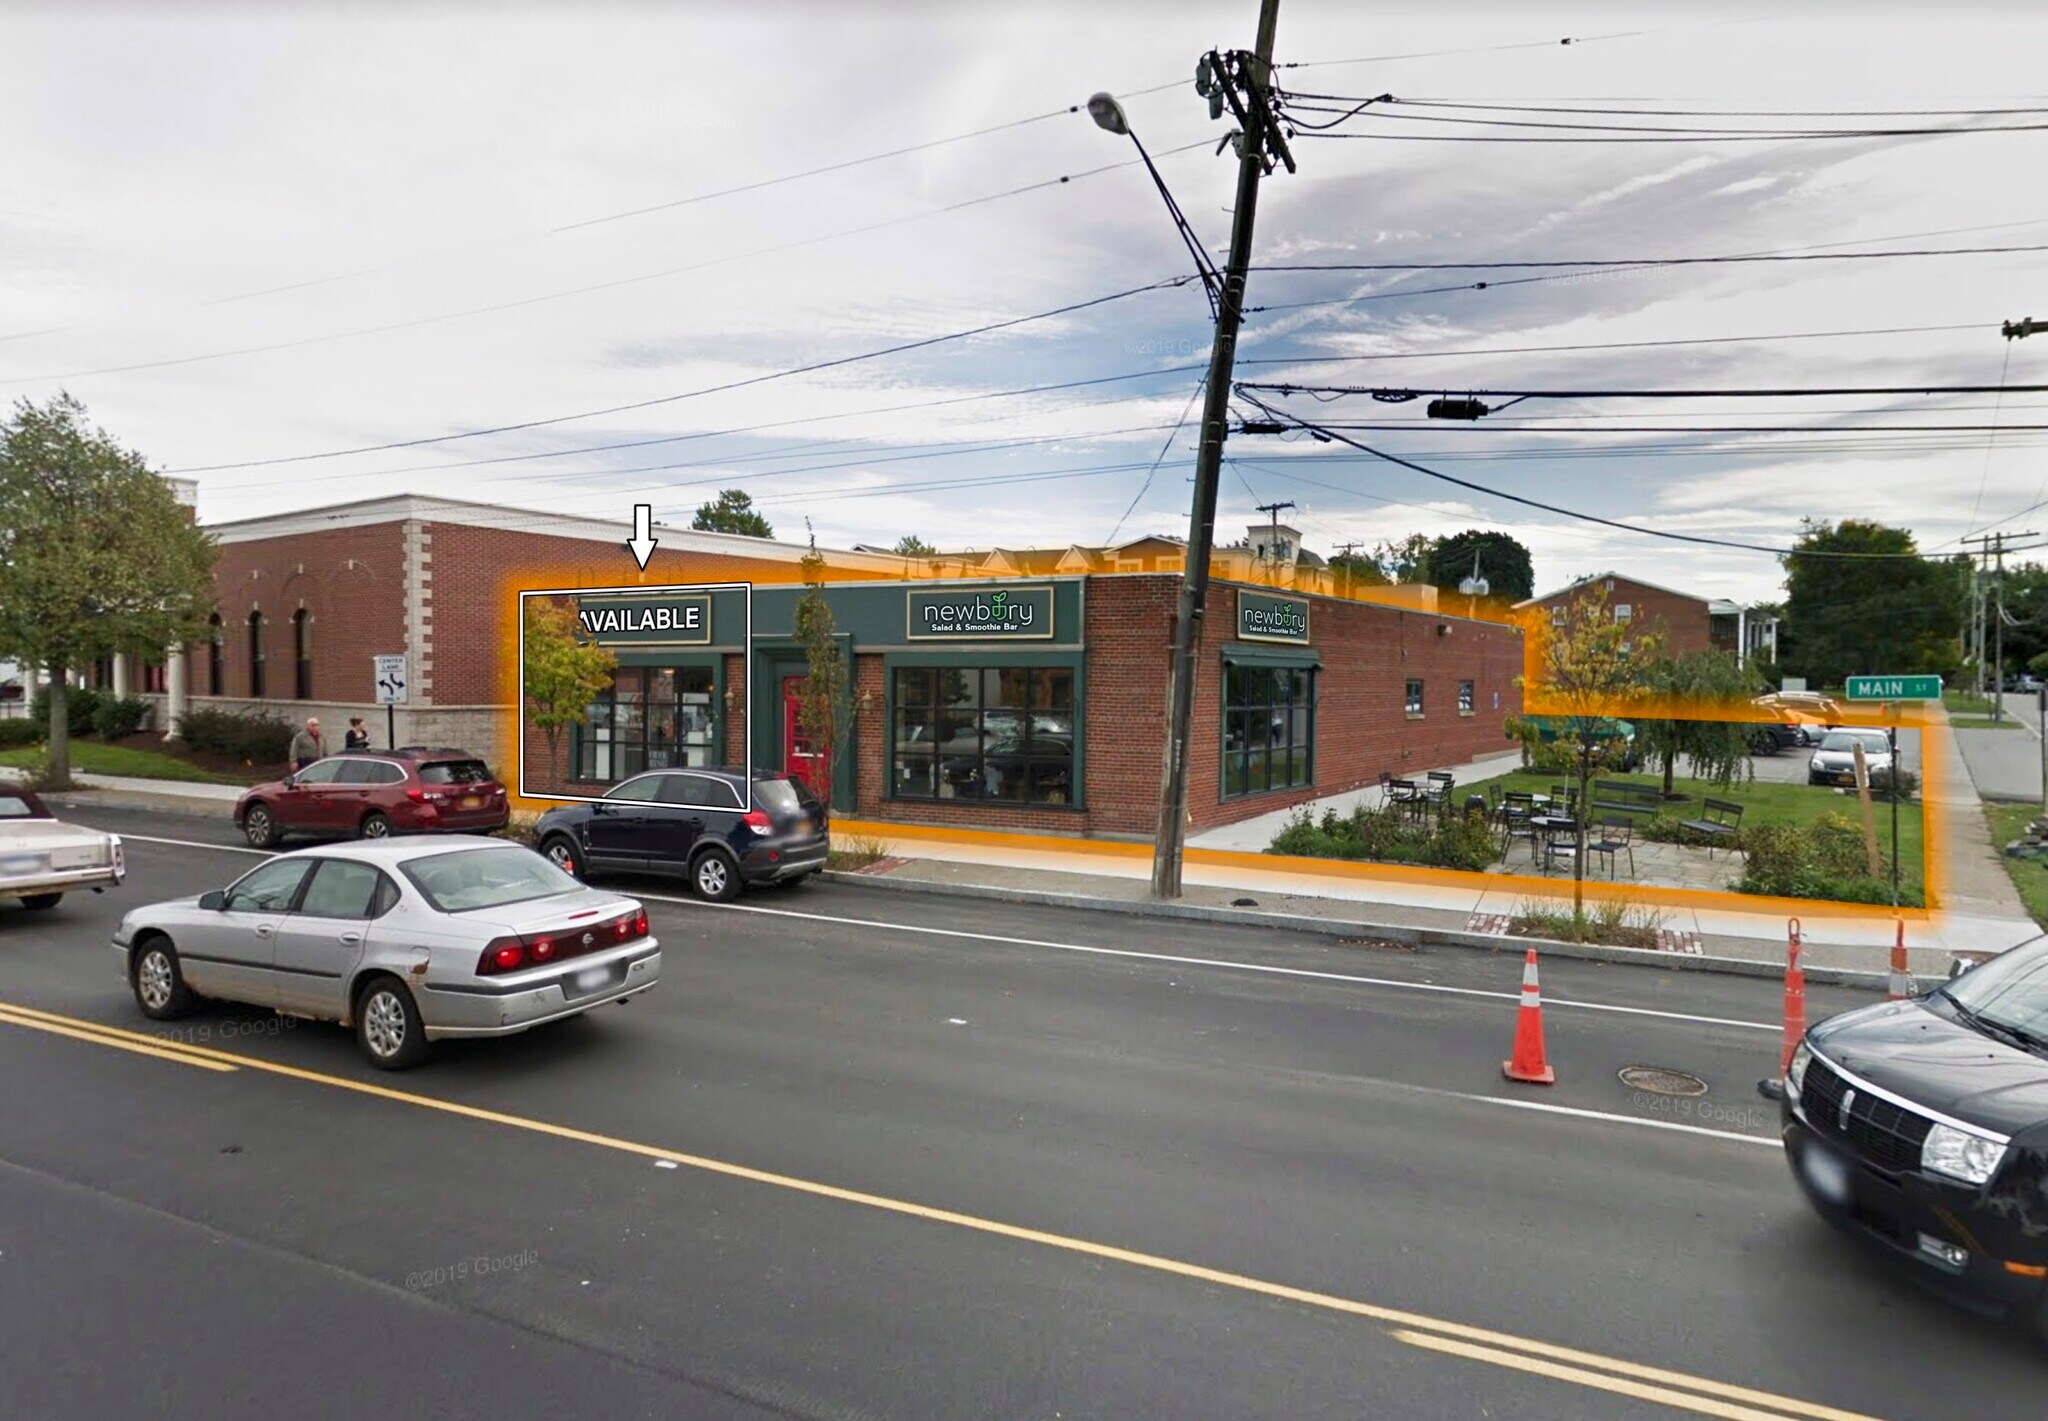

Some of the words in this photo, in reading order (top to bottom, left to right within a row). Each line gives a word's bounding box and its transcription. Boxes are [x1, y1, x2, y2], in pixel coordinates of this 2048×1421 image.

[924, 592, 1033, 625] newbury
[1244, 604, 1305, 632] newbury
[932, 623, 953, 631] Salad
[955, 623, 962, 631] &
[965, 623, 1001, 631] Smoothie
[1004, 622, 1018, 631] Bar
[1268, 627, 1289, 635] Smoothie
[1858, 681, 1903, 695] MAIN
[1915, 684, 1927, 692] ST
